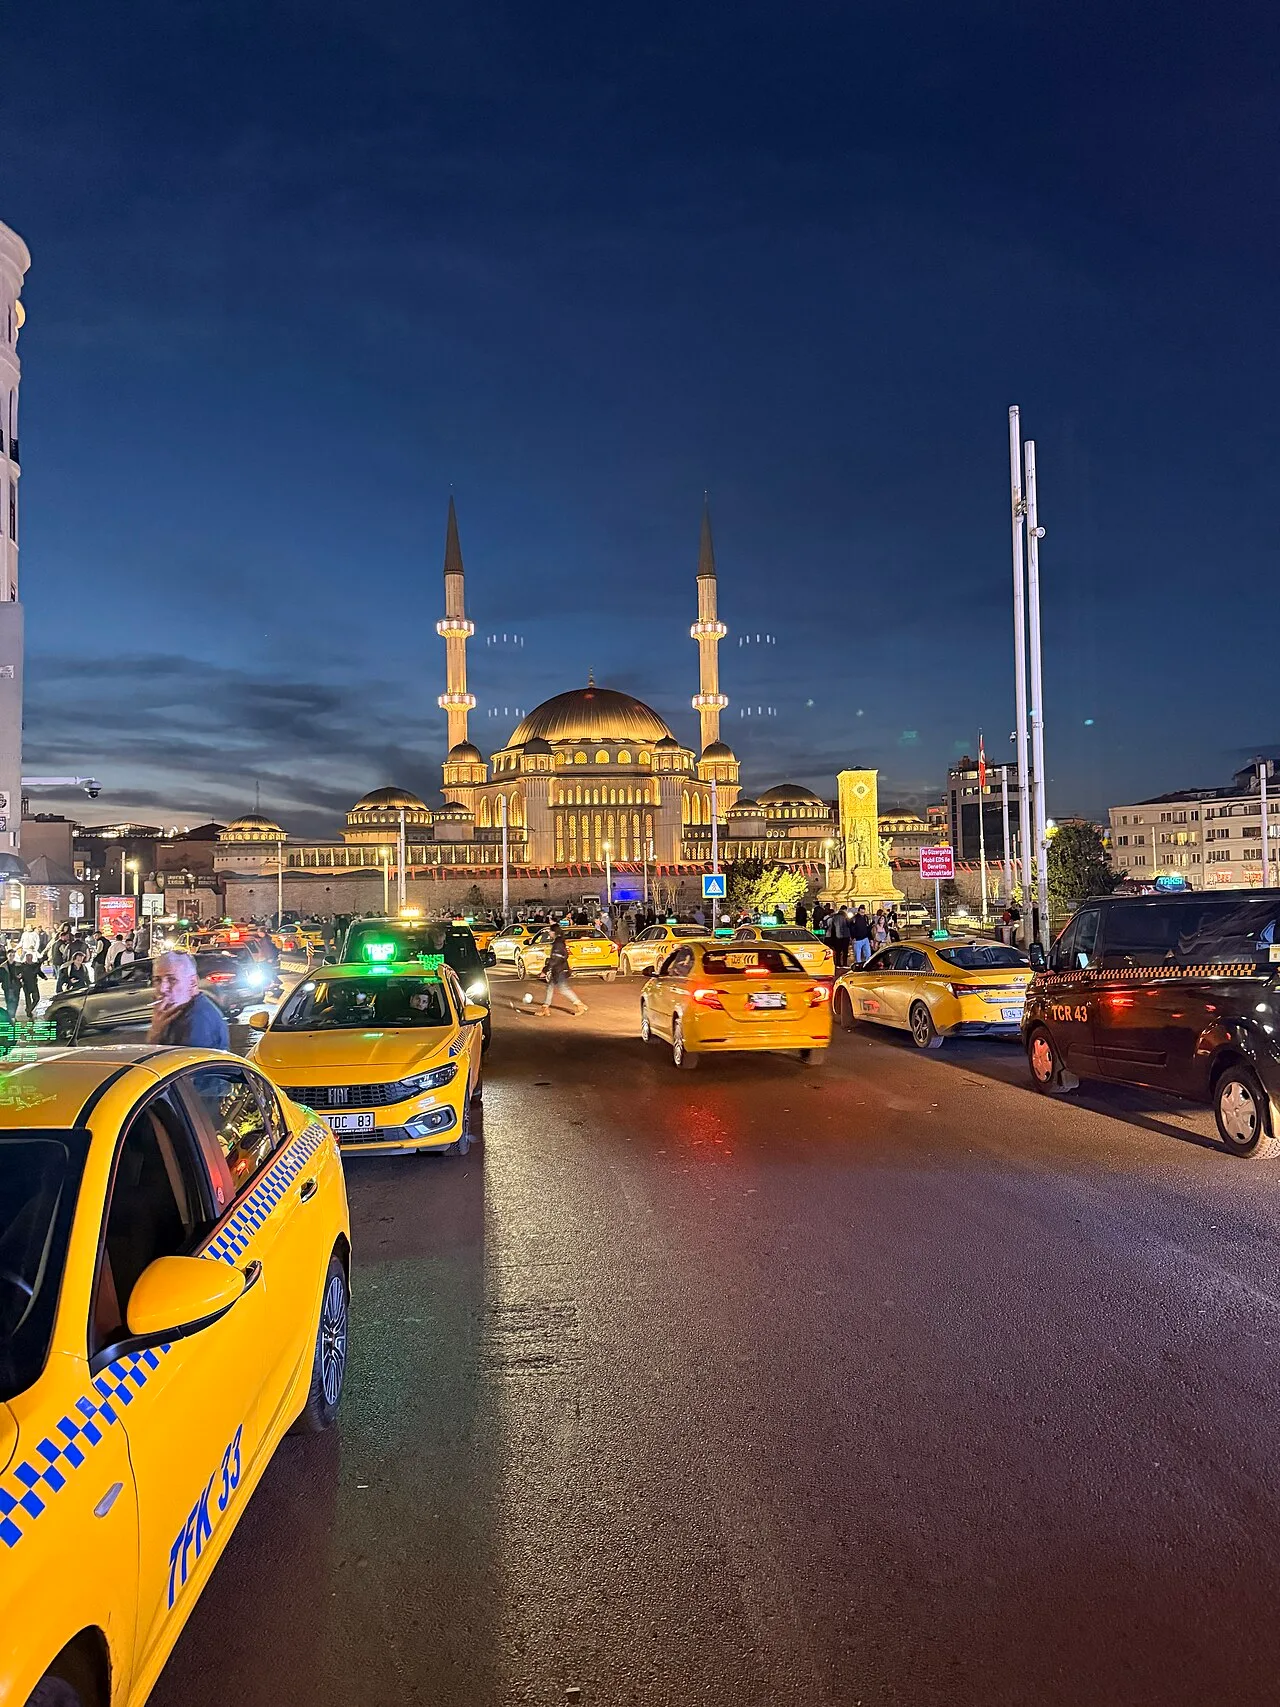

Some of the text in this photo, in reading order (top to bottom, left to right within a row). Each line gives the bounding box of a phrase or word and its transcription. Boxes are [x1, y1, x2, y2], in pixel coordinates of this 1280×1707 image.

[1052, 1005, 1088, 1022] TCR 43
[328, 1087, 349, 1103] FIAT
[328, 1115, 371, 1128] TDC 83
[168, 1423, 243, 1610] TFK 33
